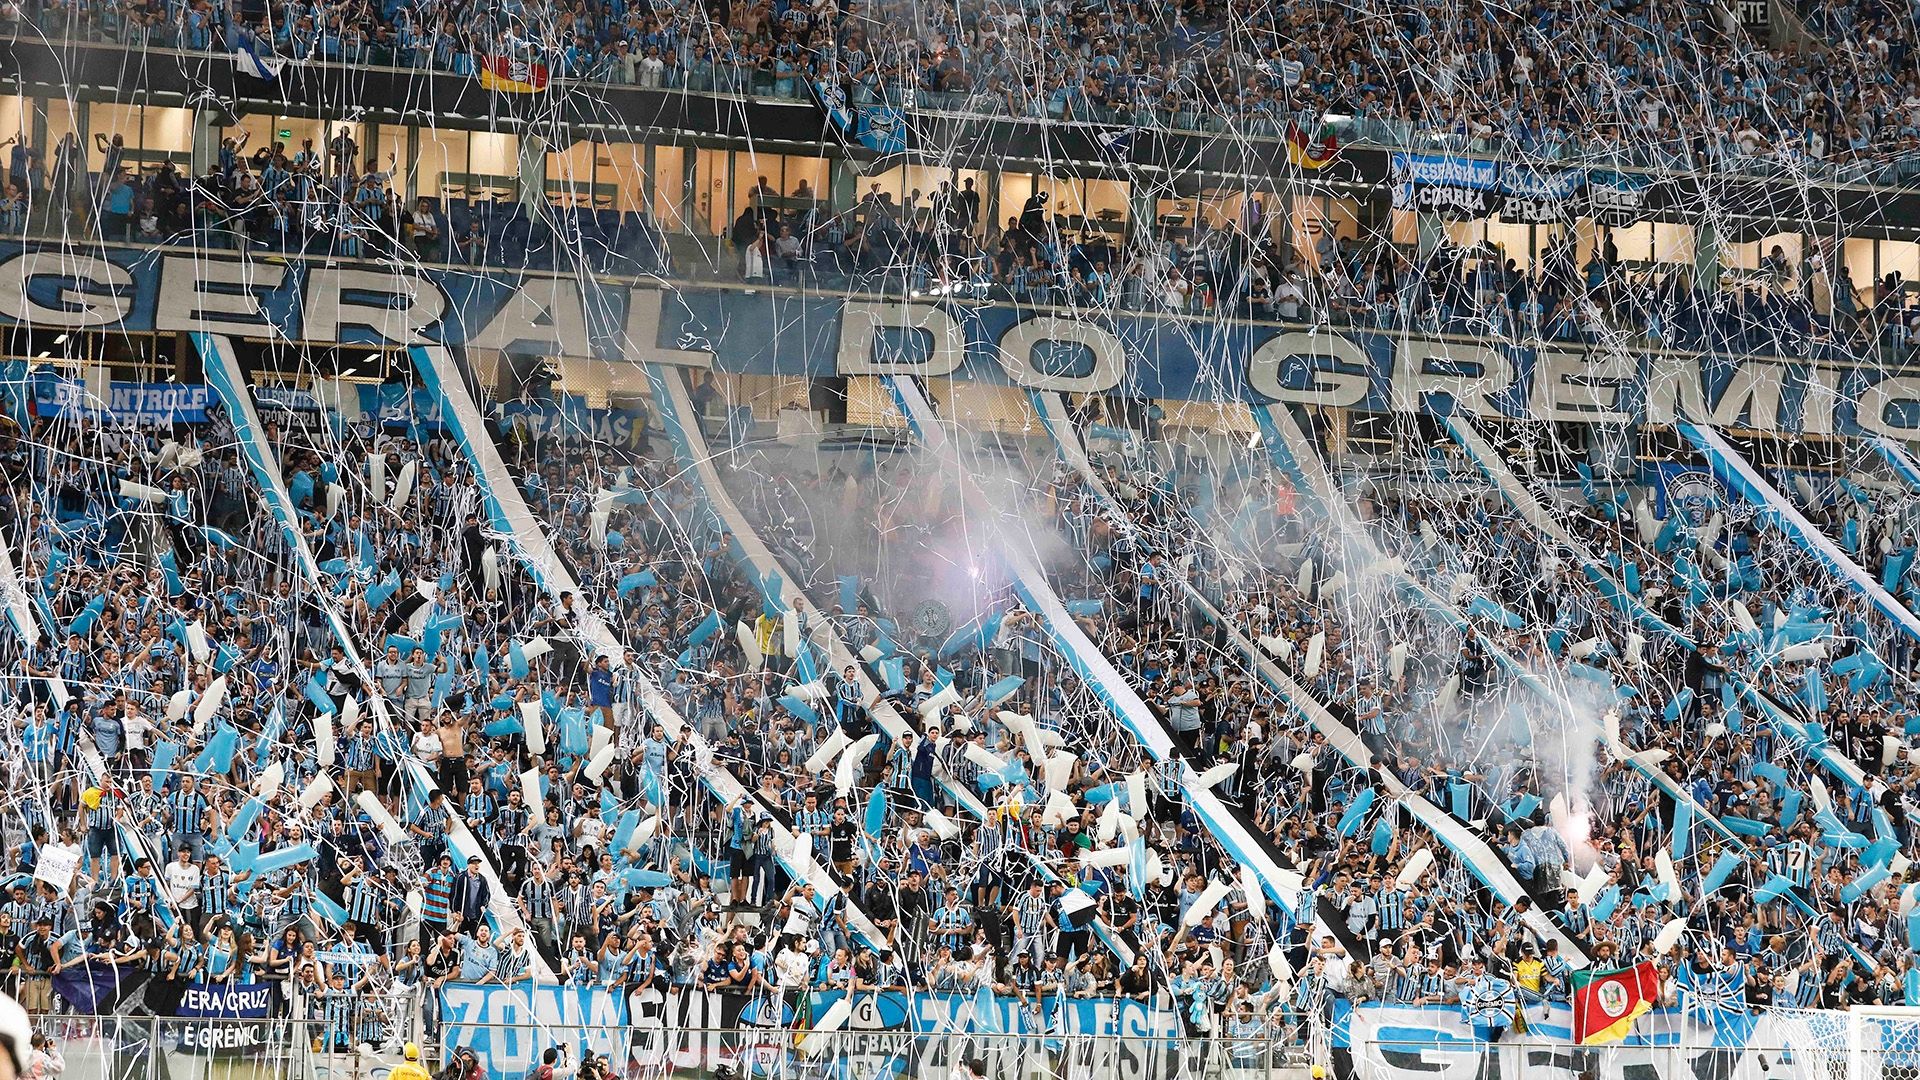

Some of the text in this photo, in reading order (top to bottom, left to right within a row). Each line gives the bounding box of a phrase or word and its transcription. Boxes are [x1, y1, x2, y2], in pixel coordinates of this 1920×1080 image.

[0, 253, 713, 368] GERAL
[836, 303, 1127, 393] DO
[1791, 851, 1801, 866] 7
[180, 988, 270, 1011] VERA CRUZ
[859, 1003, 872, 1022] G
[184, 1022, 260, 1048] É GRÊMIO
[447, 987, 723, 1074] ZONA SUL
